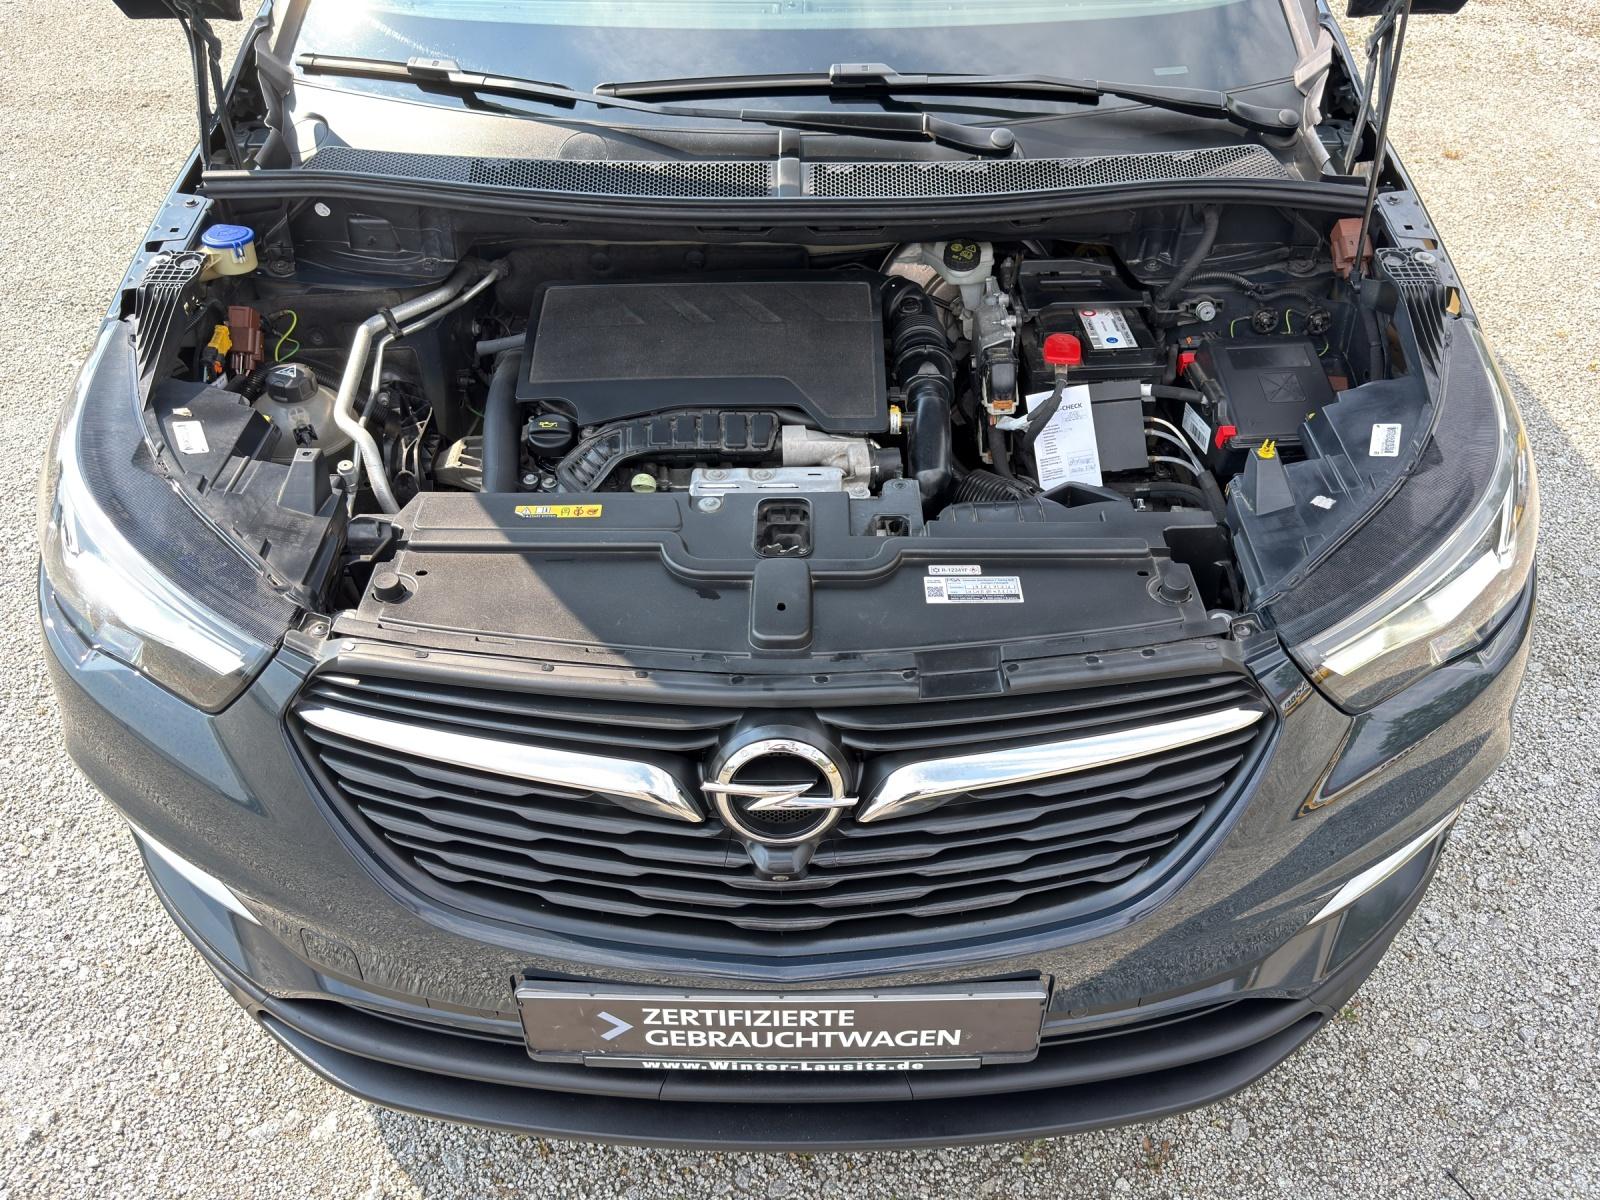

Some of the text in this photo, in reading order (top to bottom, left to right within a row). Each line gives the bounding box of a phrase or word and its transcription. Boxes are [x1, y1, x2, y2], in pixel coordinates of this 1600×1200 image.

[1057, 402, 1083, 412] -CHECK
[642, 1008, 855, 1027] ZERTIFIZIERTE
[645, 1029, 962, 1048] GEBRAUCHTWAGEN
[642, 1061, 924, 1071] www.Winter-Lausitz.de
